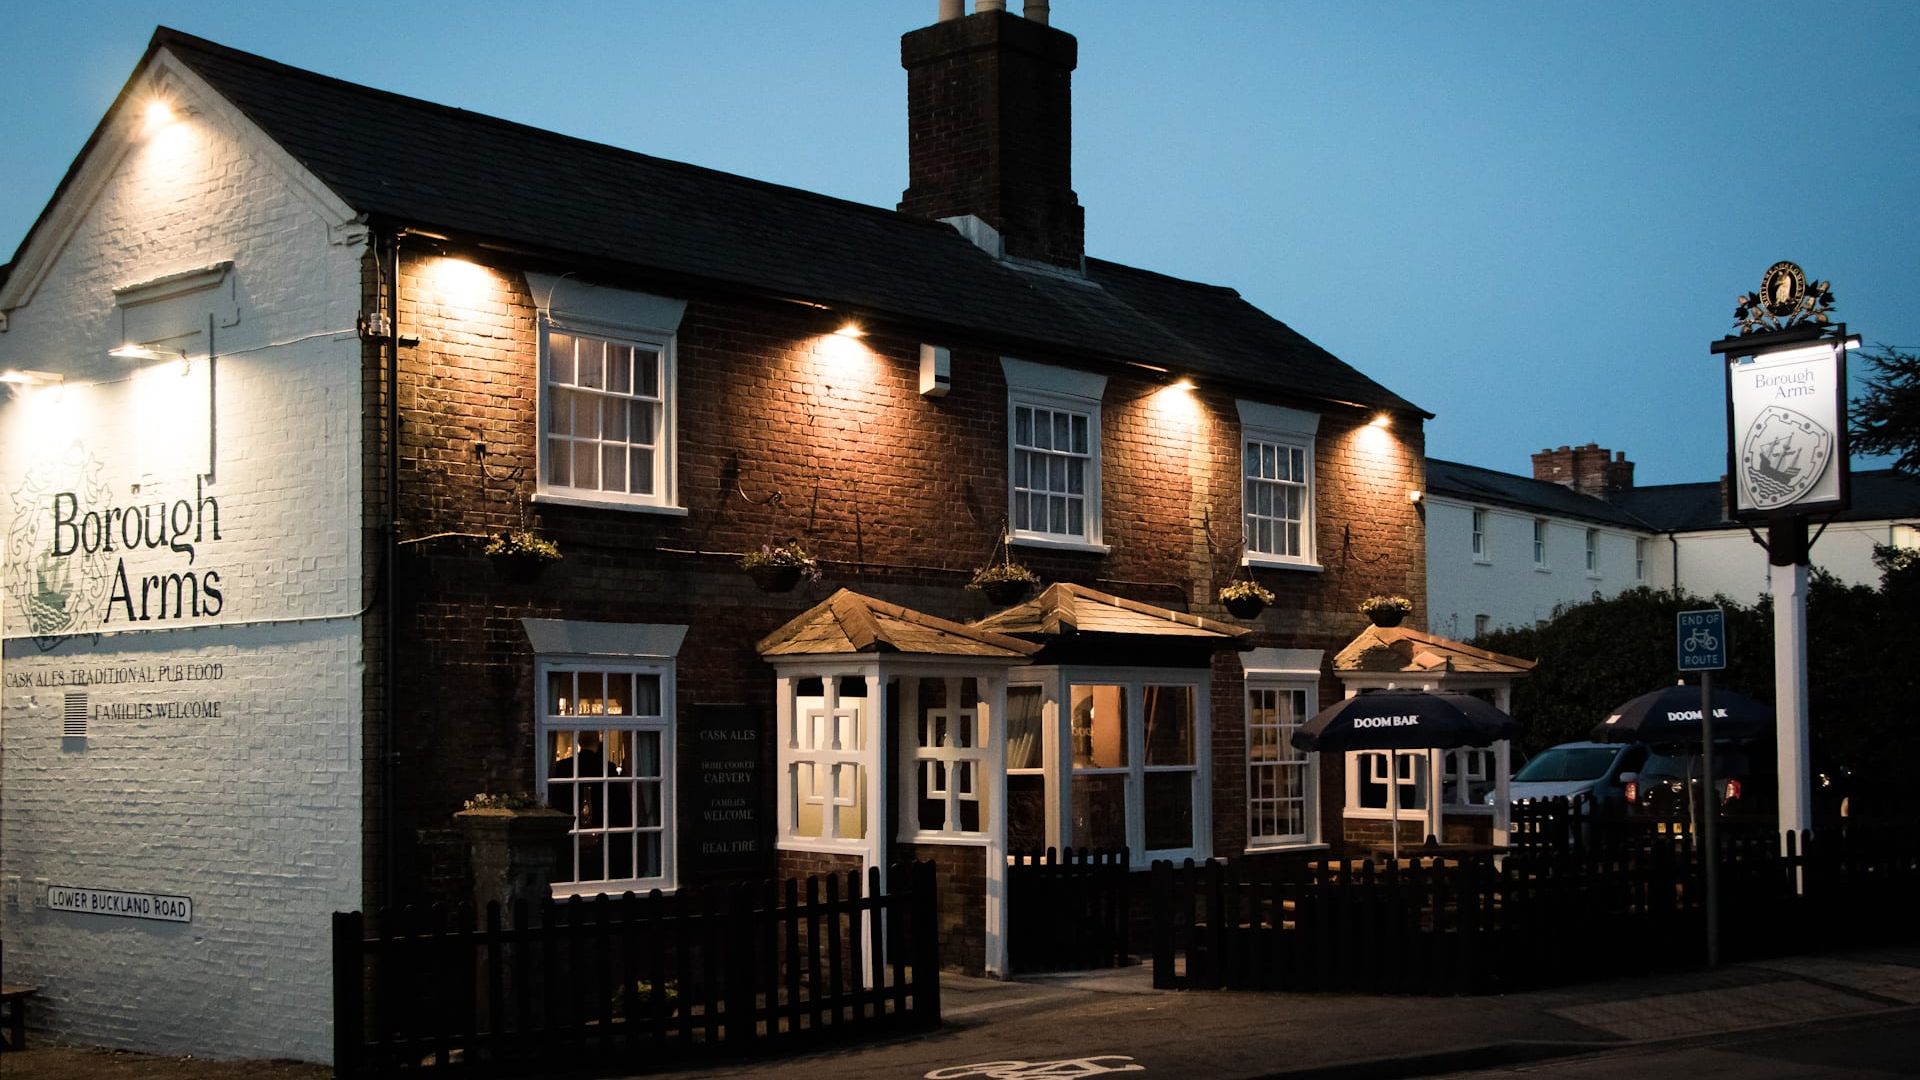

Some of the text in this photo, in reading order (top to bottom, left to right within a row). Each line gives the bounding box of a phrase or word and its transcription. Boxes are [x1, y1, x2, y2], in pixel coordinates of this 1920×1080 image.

[1755, 368, 1815, 389] Borough
[1775, 385, 1815, 398] Arms
[51, 474, 221, 565] Borough
[104, 557, 223, 623] Arms
[1681, 614, 1720, 625] END OF
[1684, 654, 1718, 665] ROUTE
[5, 663, 223, 687] CASK ALES TRADITIONAL PUB FOOD
[95, 701, 222, 721] FAMILIES WELCOME
[1666, 709, 1703, 721] DOOM
[1353, 715, 1418, 728] DOOM BAR
[700, 729, 756, 741] CASK ALES
[704, 772, 751, 783] CARVERY
[711, 799, 746, 807] FAMILIES
[704, 809, 753, 821] WELCOME
[702, 841, 756, 853] REAL FIRE
[53, 890, 186, 917] LOWER BUCKLAND ROAD
